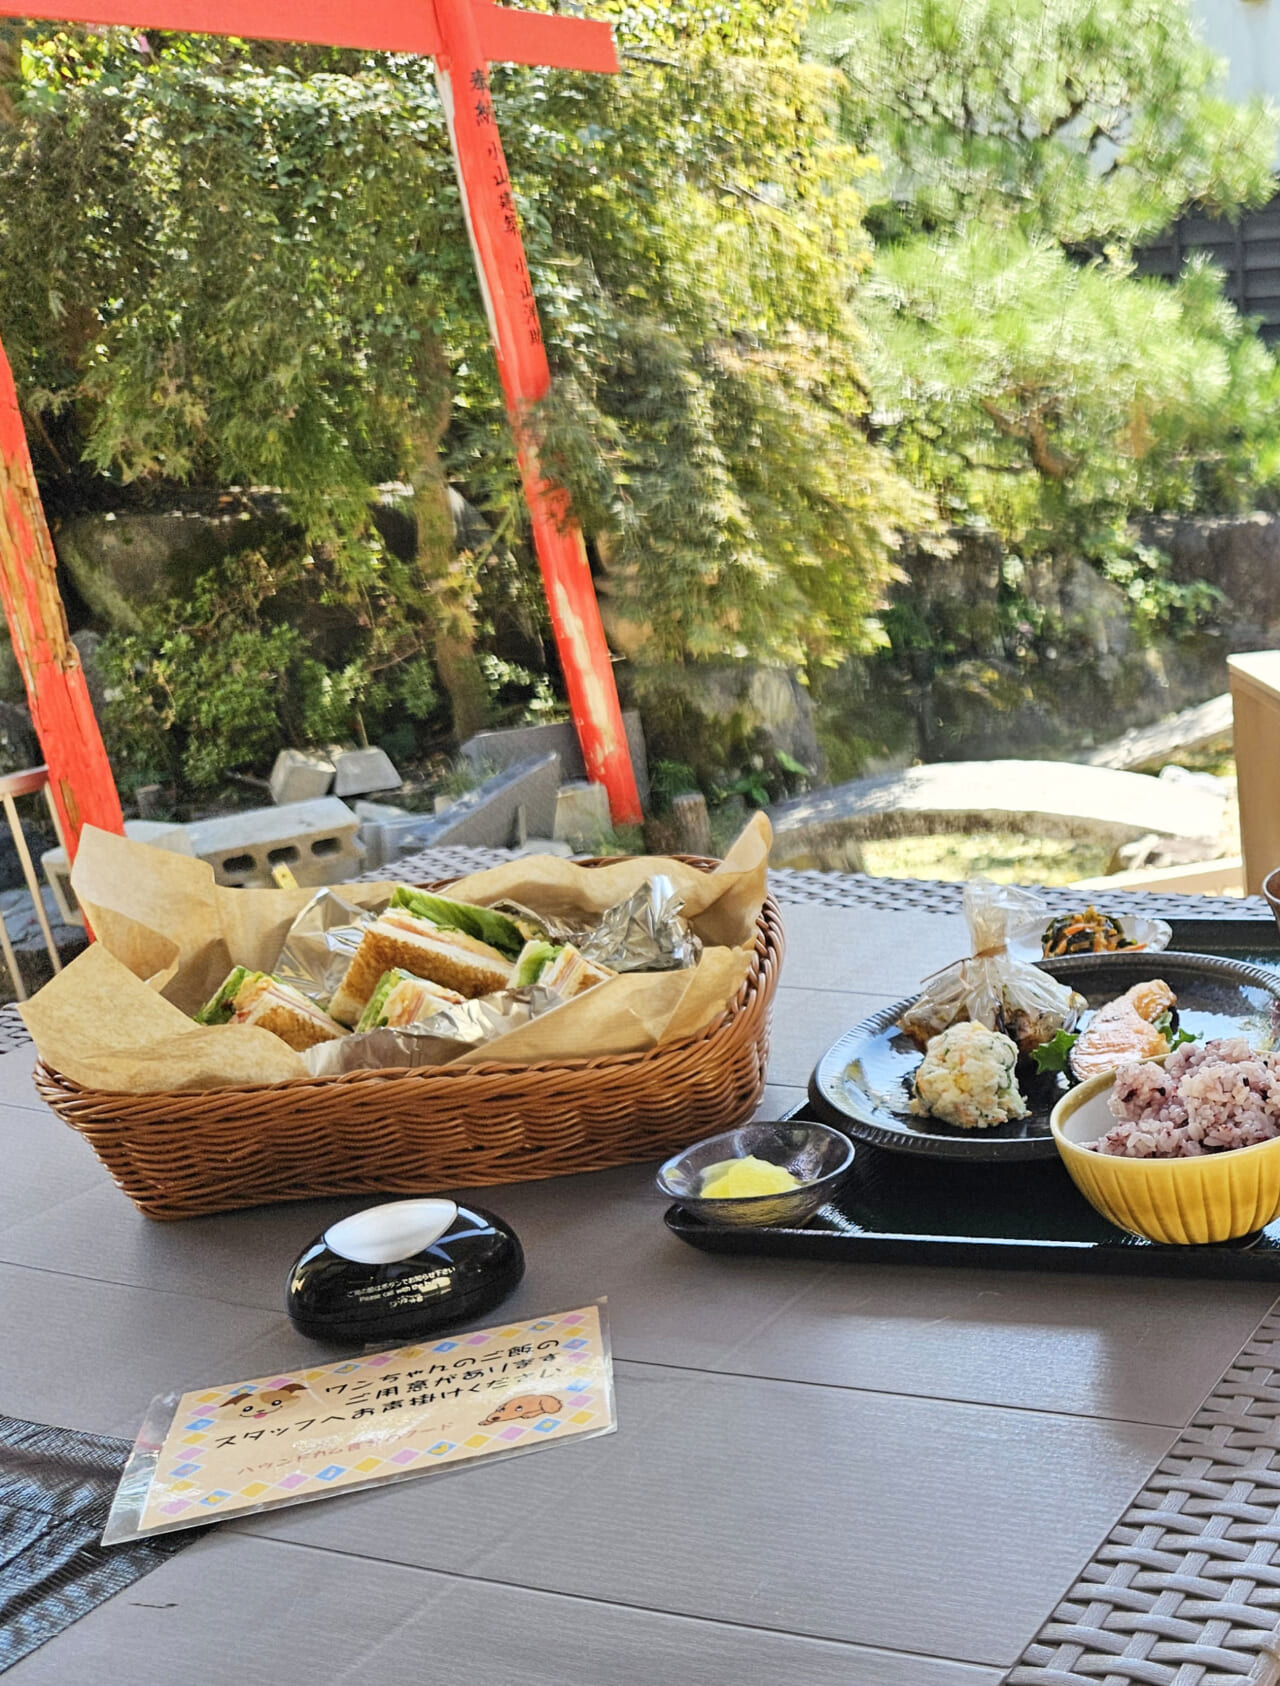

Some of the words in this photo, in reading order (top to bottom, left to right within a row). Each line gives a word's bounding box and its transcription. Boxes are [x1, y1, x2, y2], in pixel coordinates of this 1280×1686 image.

[325, 1339, 560, 1394] ワンちゃんのご飯の
[345, 1352, 560, 1405] ご用意があります
[215, 1367, 562, 1449] スタッフへお声掛けください
